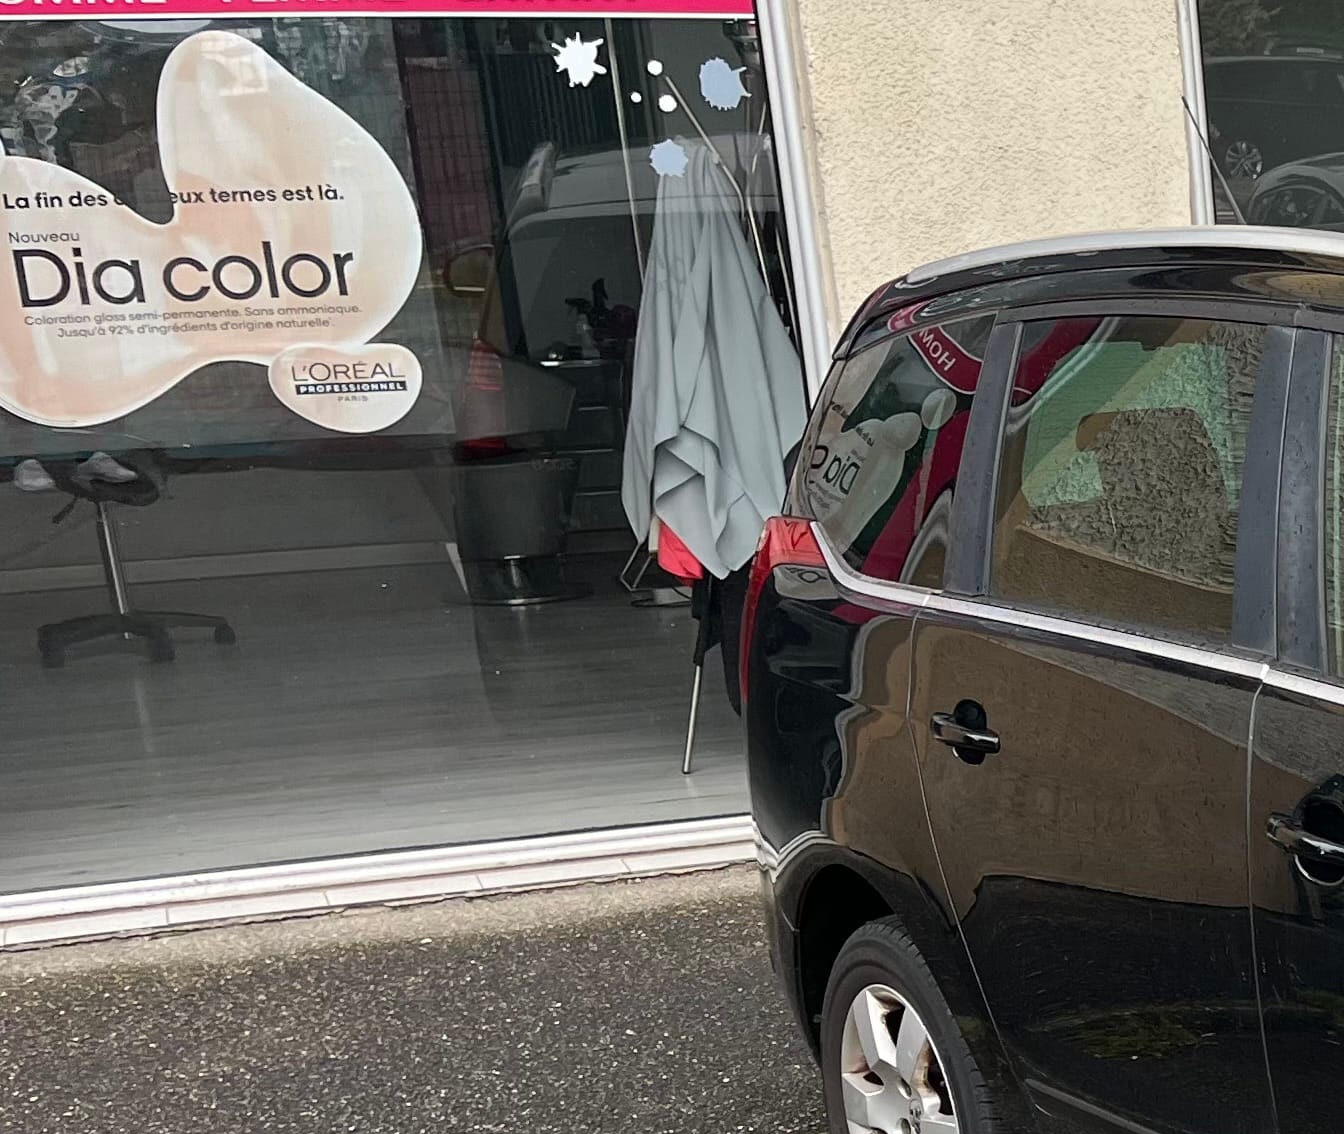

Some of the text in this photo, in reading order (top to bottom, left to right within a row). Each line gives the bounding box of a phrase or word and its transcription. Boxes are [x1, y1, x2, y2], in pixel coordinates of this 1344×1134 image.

[2, 193, 30, 209] La
[36, 192, 62, 208] fin
[69, 191, 108, 207] des
[209, 188, 276, 203] ternes
[282, 186, 314, 201] est
[318, 184, 345, 200] là.
[8, 232, 80, 244] Nouveau
[12, 241, 354, 308] Dia color
[24, 314, 91, 326] Coloration
[94, 313, 126, 325] gloss
[244, 307, 274, 317] Sans
[277, 305, 362, 316] ammoniaque.
[57, 326, 105, 338] Jusqu'à
[109, 325, 135, 335] 92%
[137, 321, 218, 335] d'ingrédients
[220, 320, 273, 332] d'origine
[291, 360, 406, 382] L'ORÉAL
[299, 382, 404, 394] PROFESSIONNEL
